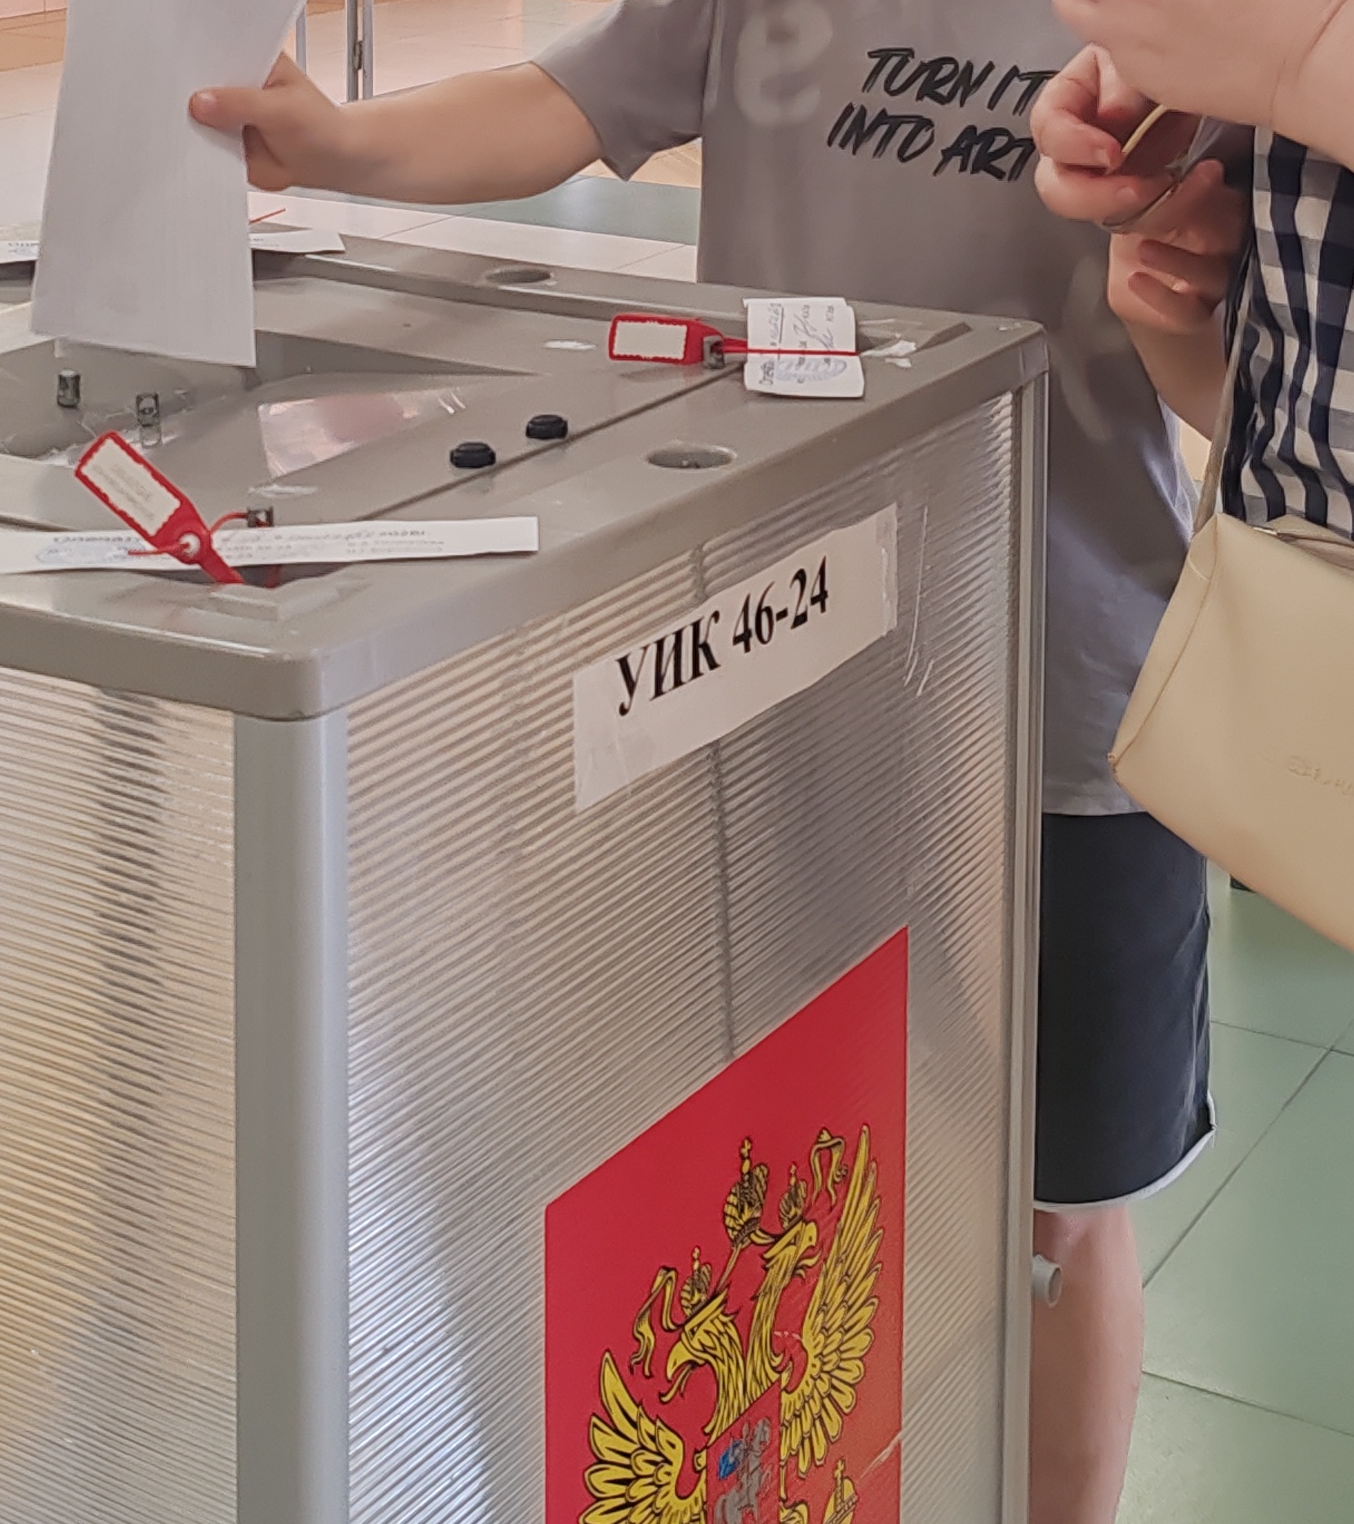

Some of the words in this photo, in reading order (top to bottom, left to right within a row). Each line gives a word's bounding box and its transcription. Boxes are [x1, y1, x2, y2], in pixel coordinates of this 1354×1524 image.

[861, 47, 995, 109] TURN
[987, 64, 1062, 117] IT
[826, 101, 935, 164] INTO
[932, 124, 1036, 182] ART
[614, 609, 722, 717] УИК
[732, 554, 829, 654] 46-24
